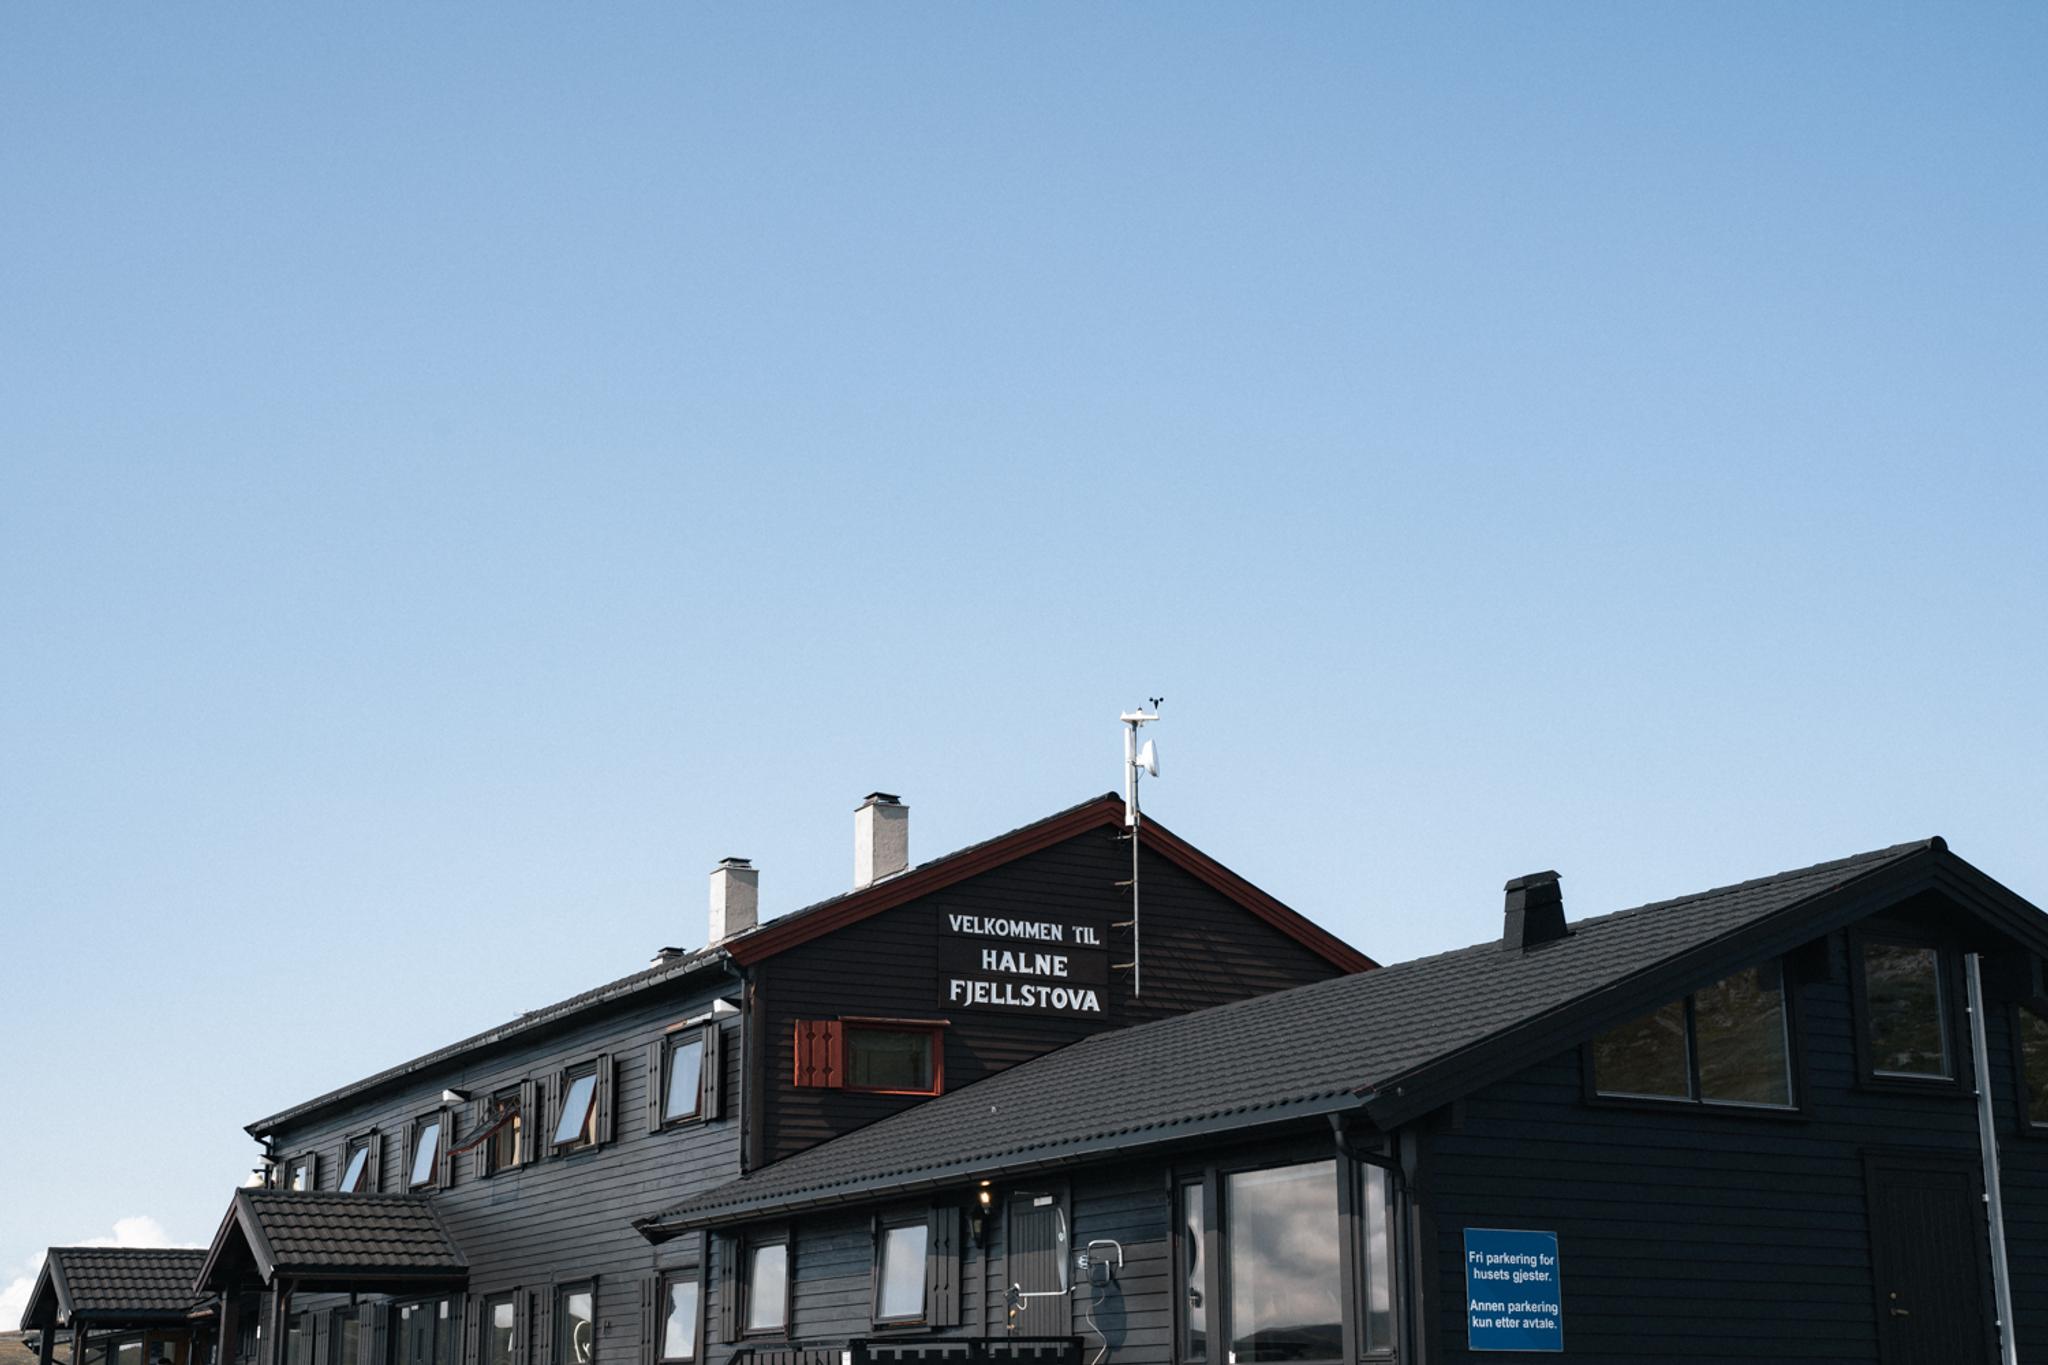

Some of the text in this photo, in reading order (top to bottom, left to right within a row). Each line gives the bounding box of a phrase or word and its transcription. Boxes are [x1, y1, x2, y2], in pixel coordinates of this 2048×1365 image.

[949, 914, 1100, 945] VELKOMMEN TIL
[981, 949, 1068, 977] HALNE
[950, 979, 1101, 1012] FJELLSTOVA
[1469, 1250, 1555, 1268] Fri parkering for
[1473, 1268, 1553, 1284] husets gjester.
[1470, 1299, 1559, 1316] Annen parkering
[1472, 1316, 1558, 1329] kun etter avtale.
